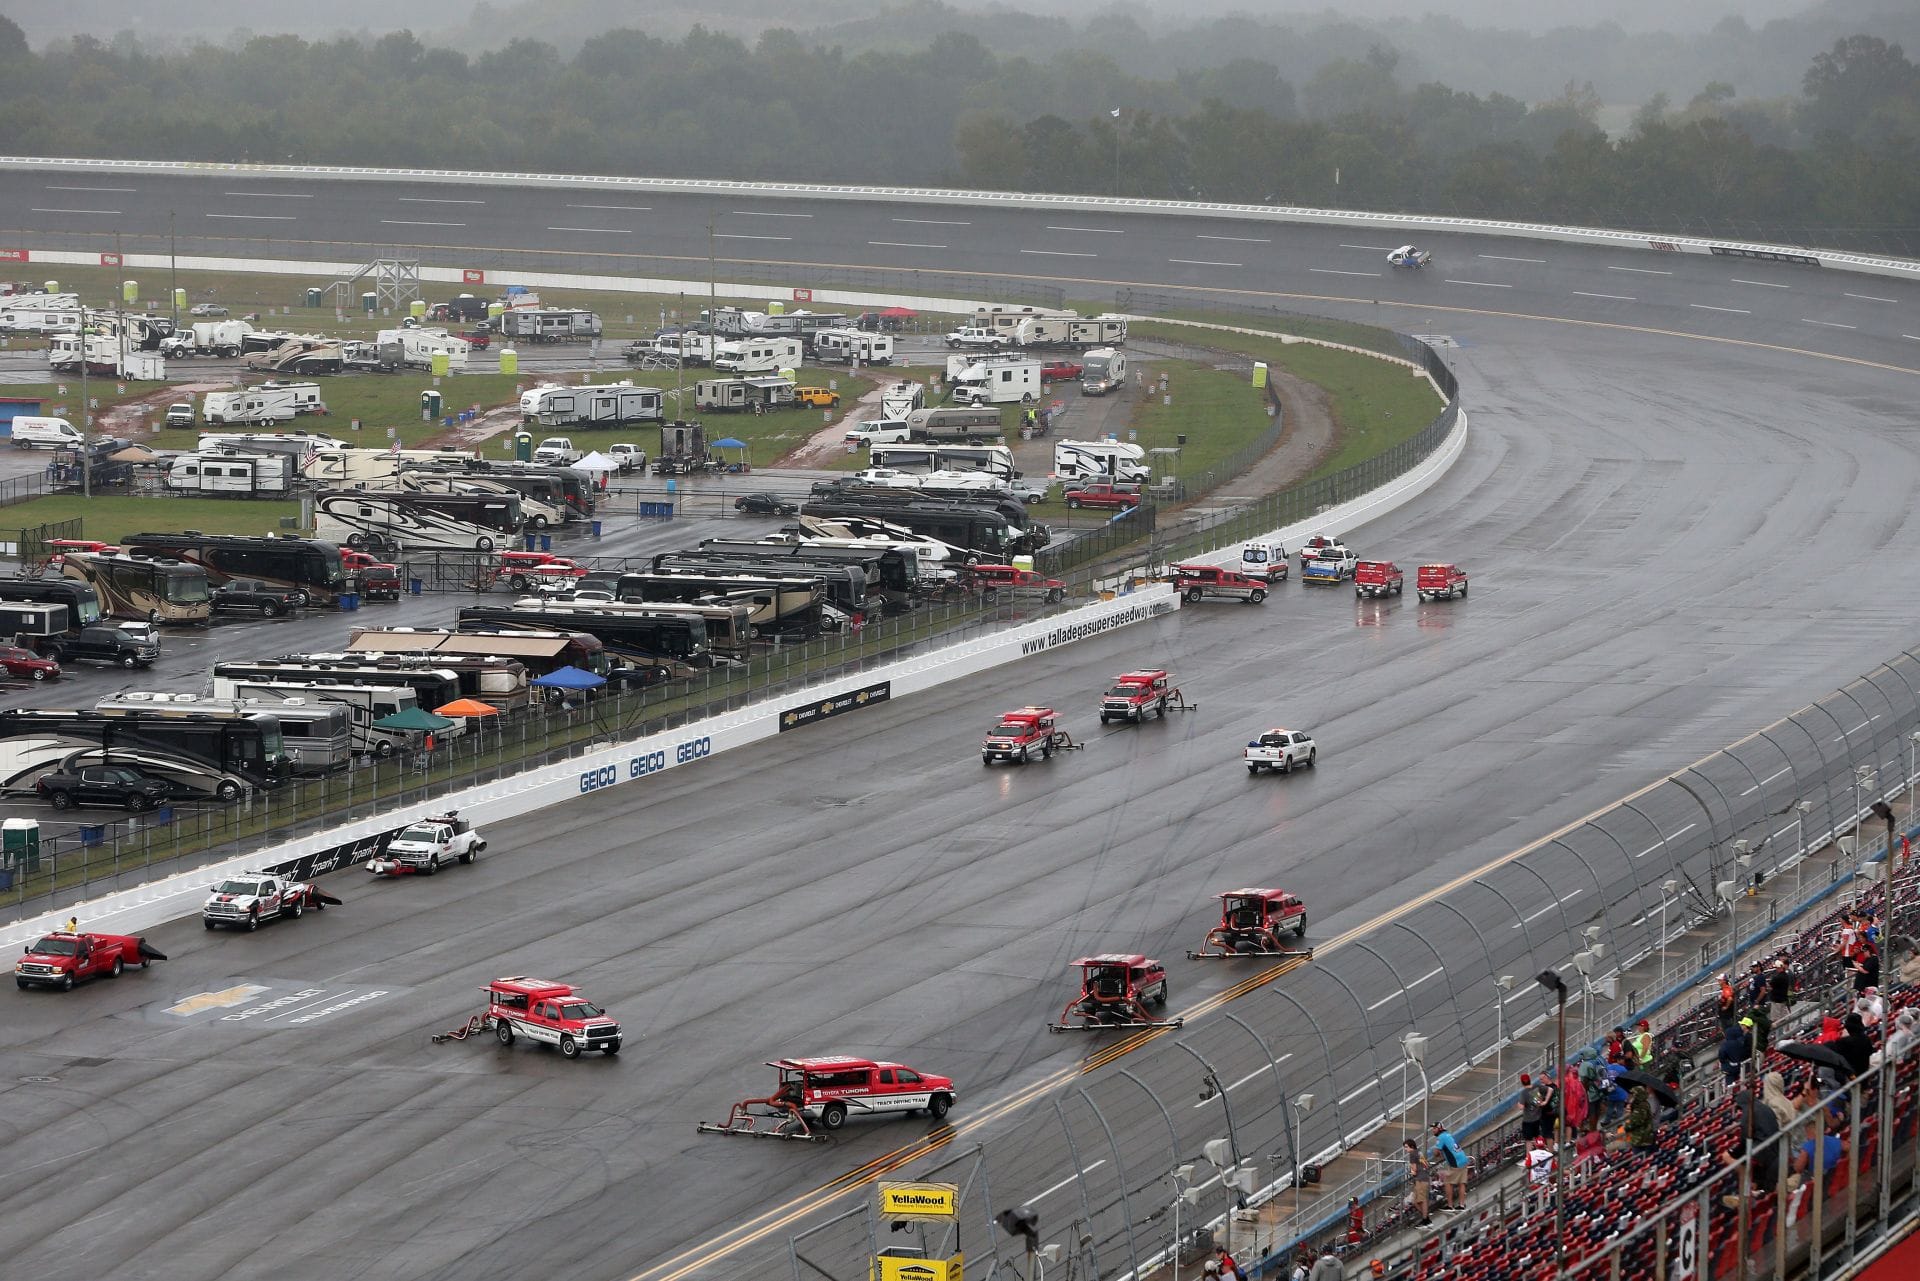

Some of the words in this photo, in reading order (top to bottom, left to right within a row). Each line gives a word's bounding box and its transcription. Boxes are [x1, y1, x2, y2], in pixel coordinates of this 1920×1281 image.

[1648, 241, 1675, 251] TURN
[676, 736, 711, 763] GEICO
[630, 751, 665, 778] GEICO
[580, 765, 616, 793] GEICO
[891, 1195, 945, 1204] YellaWood
[1682, 1228, 1692, 1270] C
